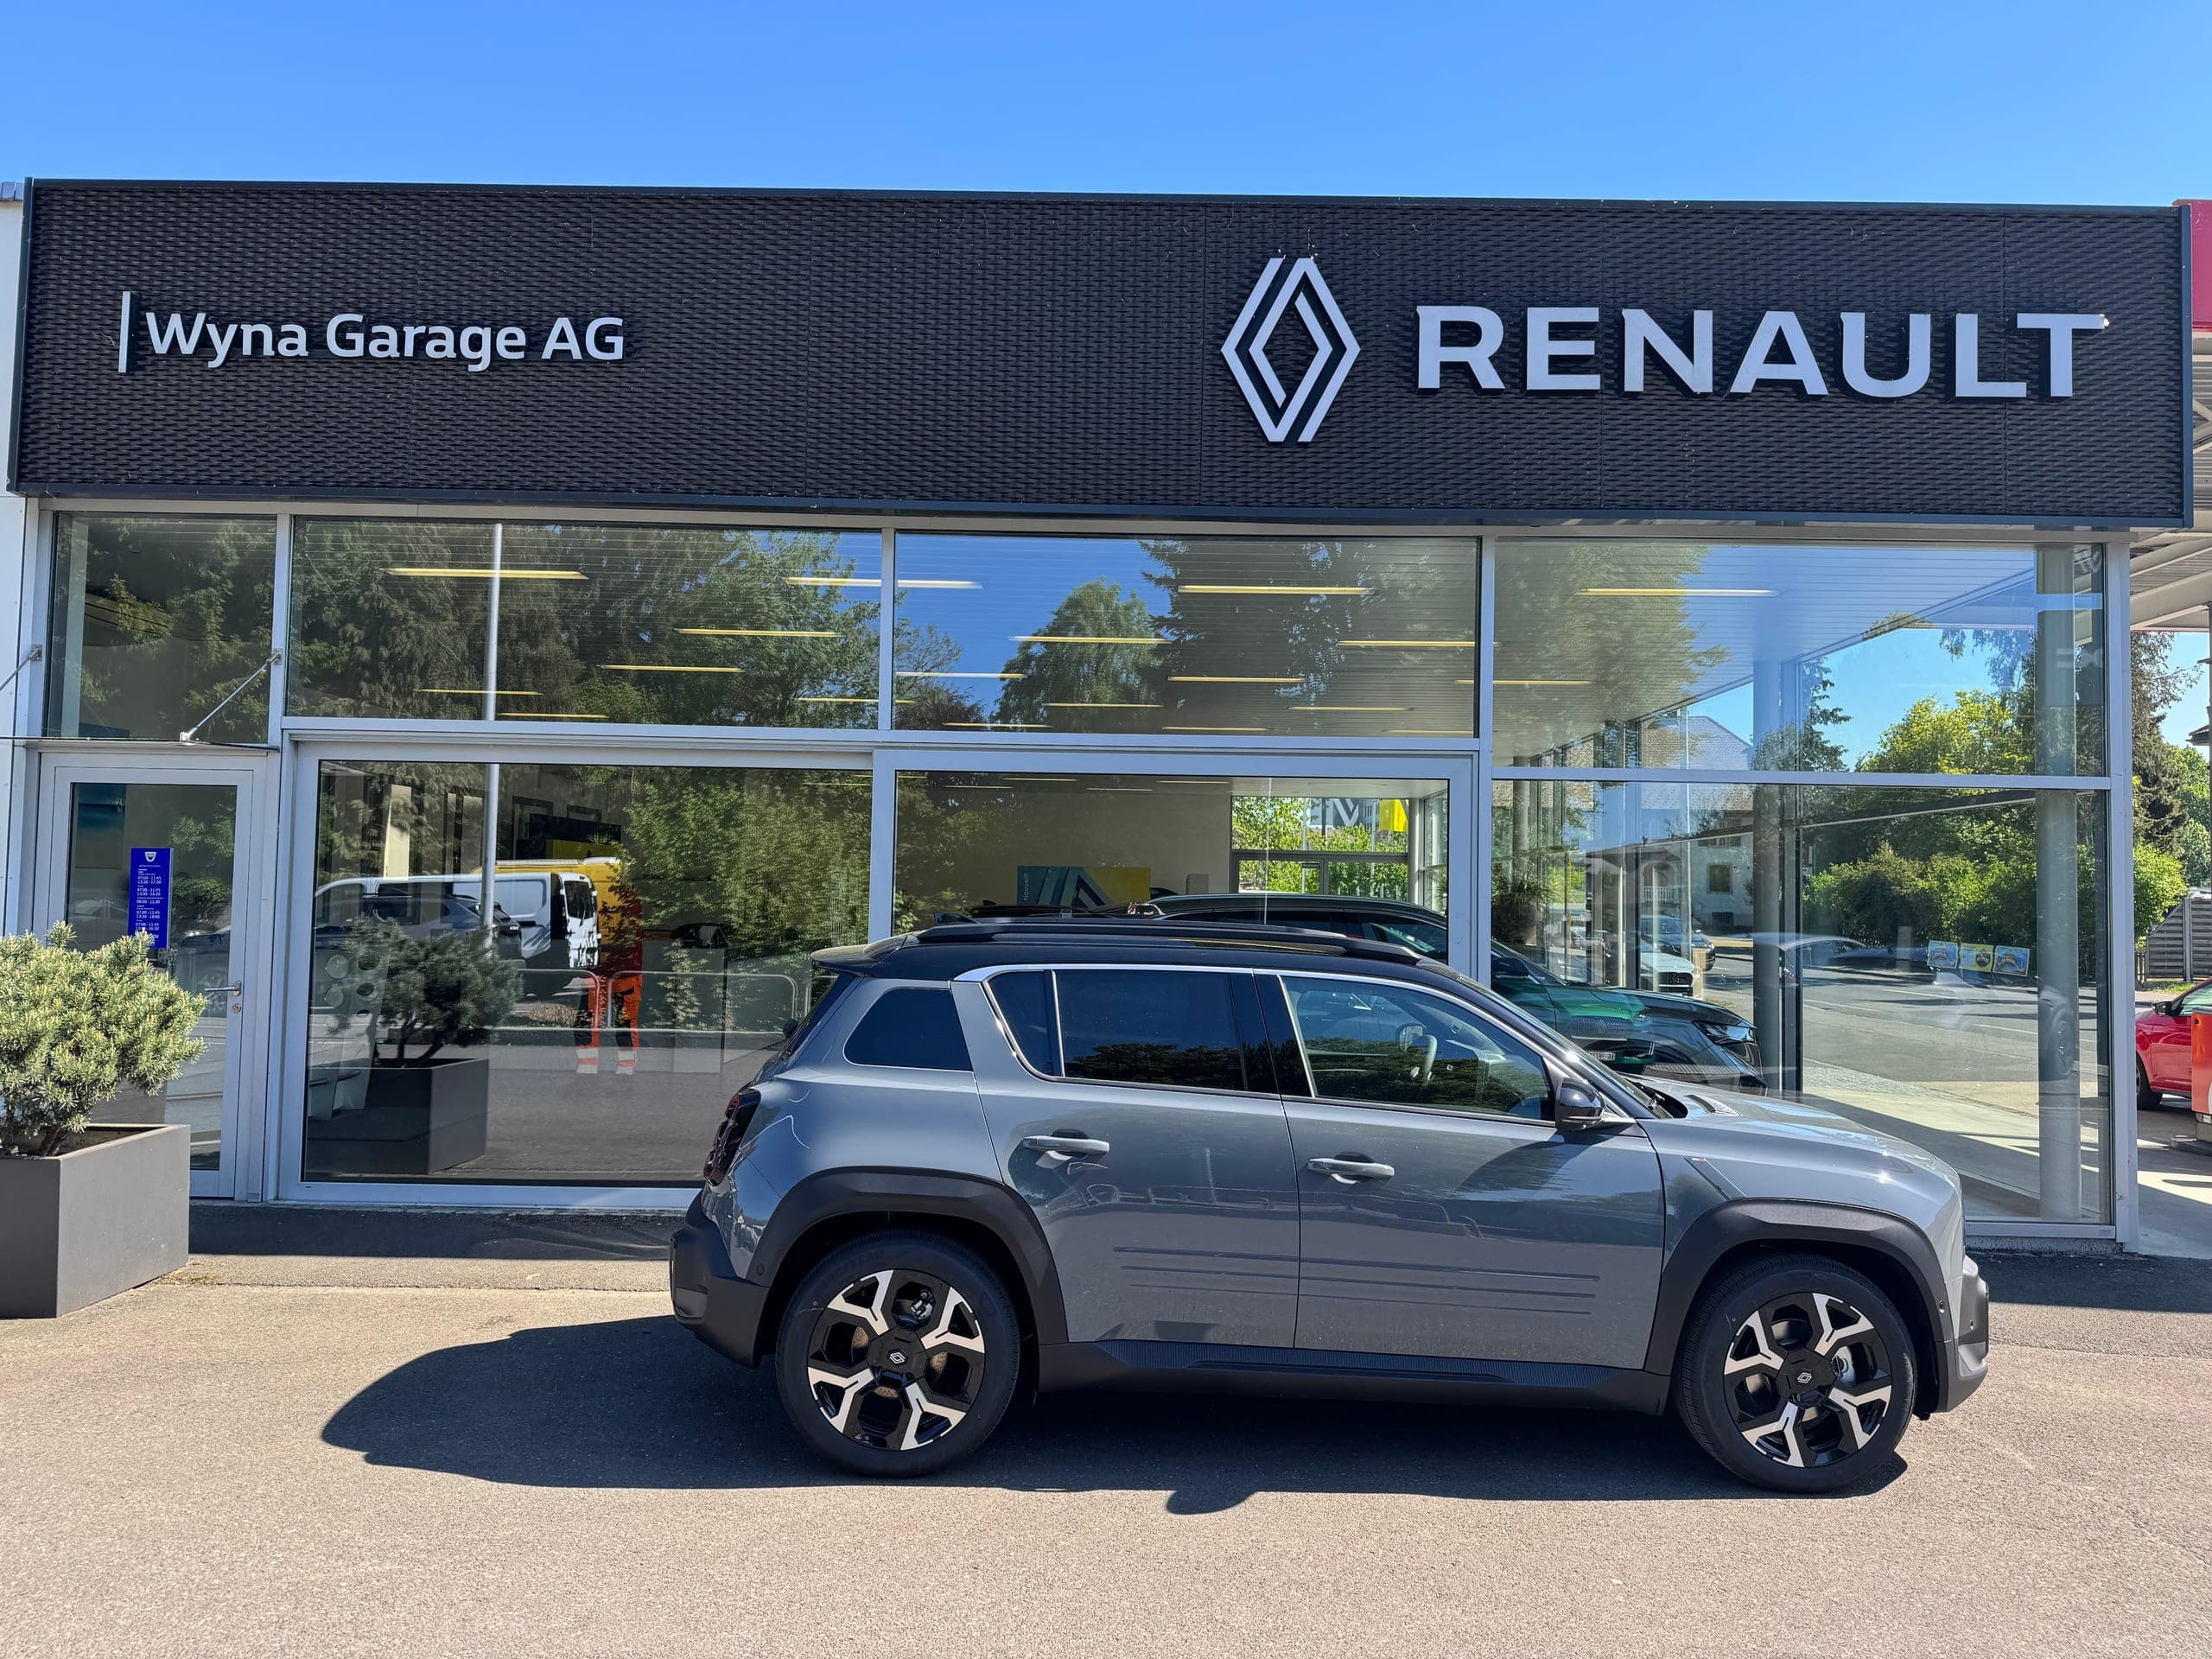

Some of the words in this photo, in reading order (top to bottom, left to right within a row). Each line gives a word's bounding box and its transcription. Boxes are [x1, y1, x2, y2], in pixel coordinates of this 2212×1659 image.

[145, 312, 309, 368] Wyna
[326, 313, 526, 372] Garage
[541, 316, 625, 360] AG
[1416, 305, 2110, 397] RENAULT
